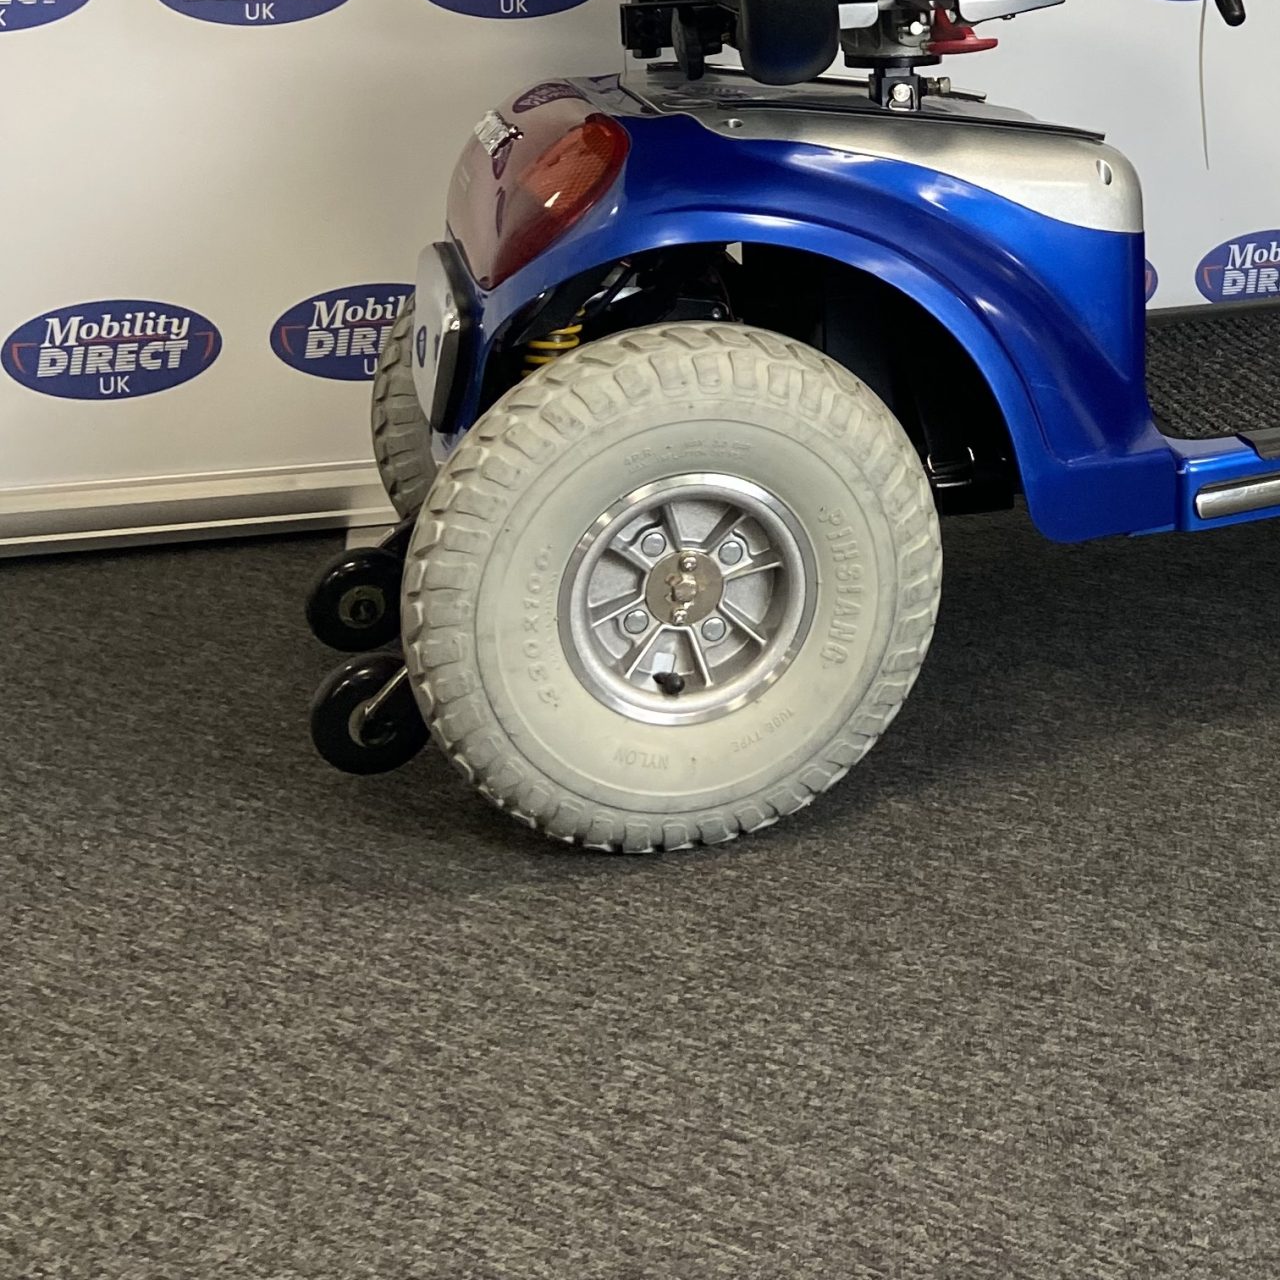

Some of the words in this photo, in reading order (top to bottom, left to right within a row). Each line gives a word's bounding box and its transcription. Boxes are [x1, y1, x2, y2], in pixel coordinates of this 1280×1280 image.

[244, 2, 275, 20] UK
[308, 295, 407, 331] Mobil
[40, 314, 190, 348] Mobility
[304, 325, 394, 360] DIR
[36, 339, 189, 378] DIRECT
[99, 375, 130, 394] UK
